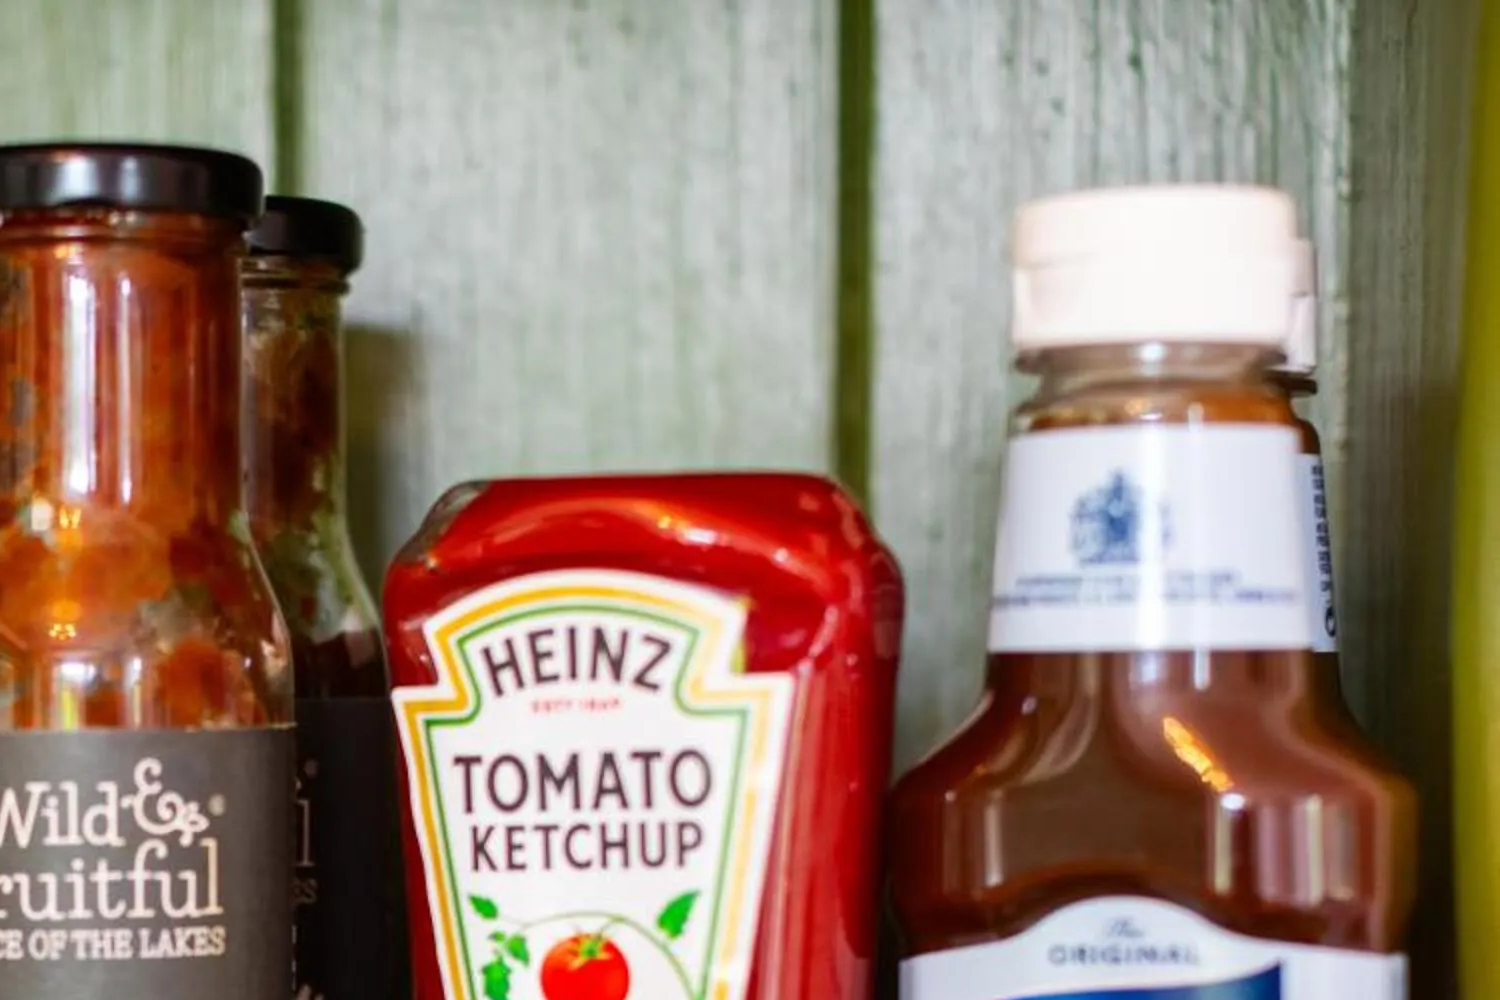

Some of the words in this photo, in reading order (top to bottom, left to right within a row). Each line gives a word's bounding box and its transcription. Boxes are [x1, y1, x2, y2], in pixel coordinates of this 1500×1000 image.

[481, 626, 672, 698] HEINZ
[454, 749, 713, 815] TOMATO
[471, 822, 705, 872] KETCHUP
[29, 929, 67, 960] OF
[68, 929, 132, 959] THE
[139, 926, 226, 959] LAKES
